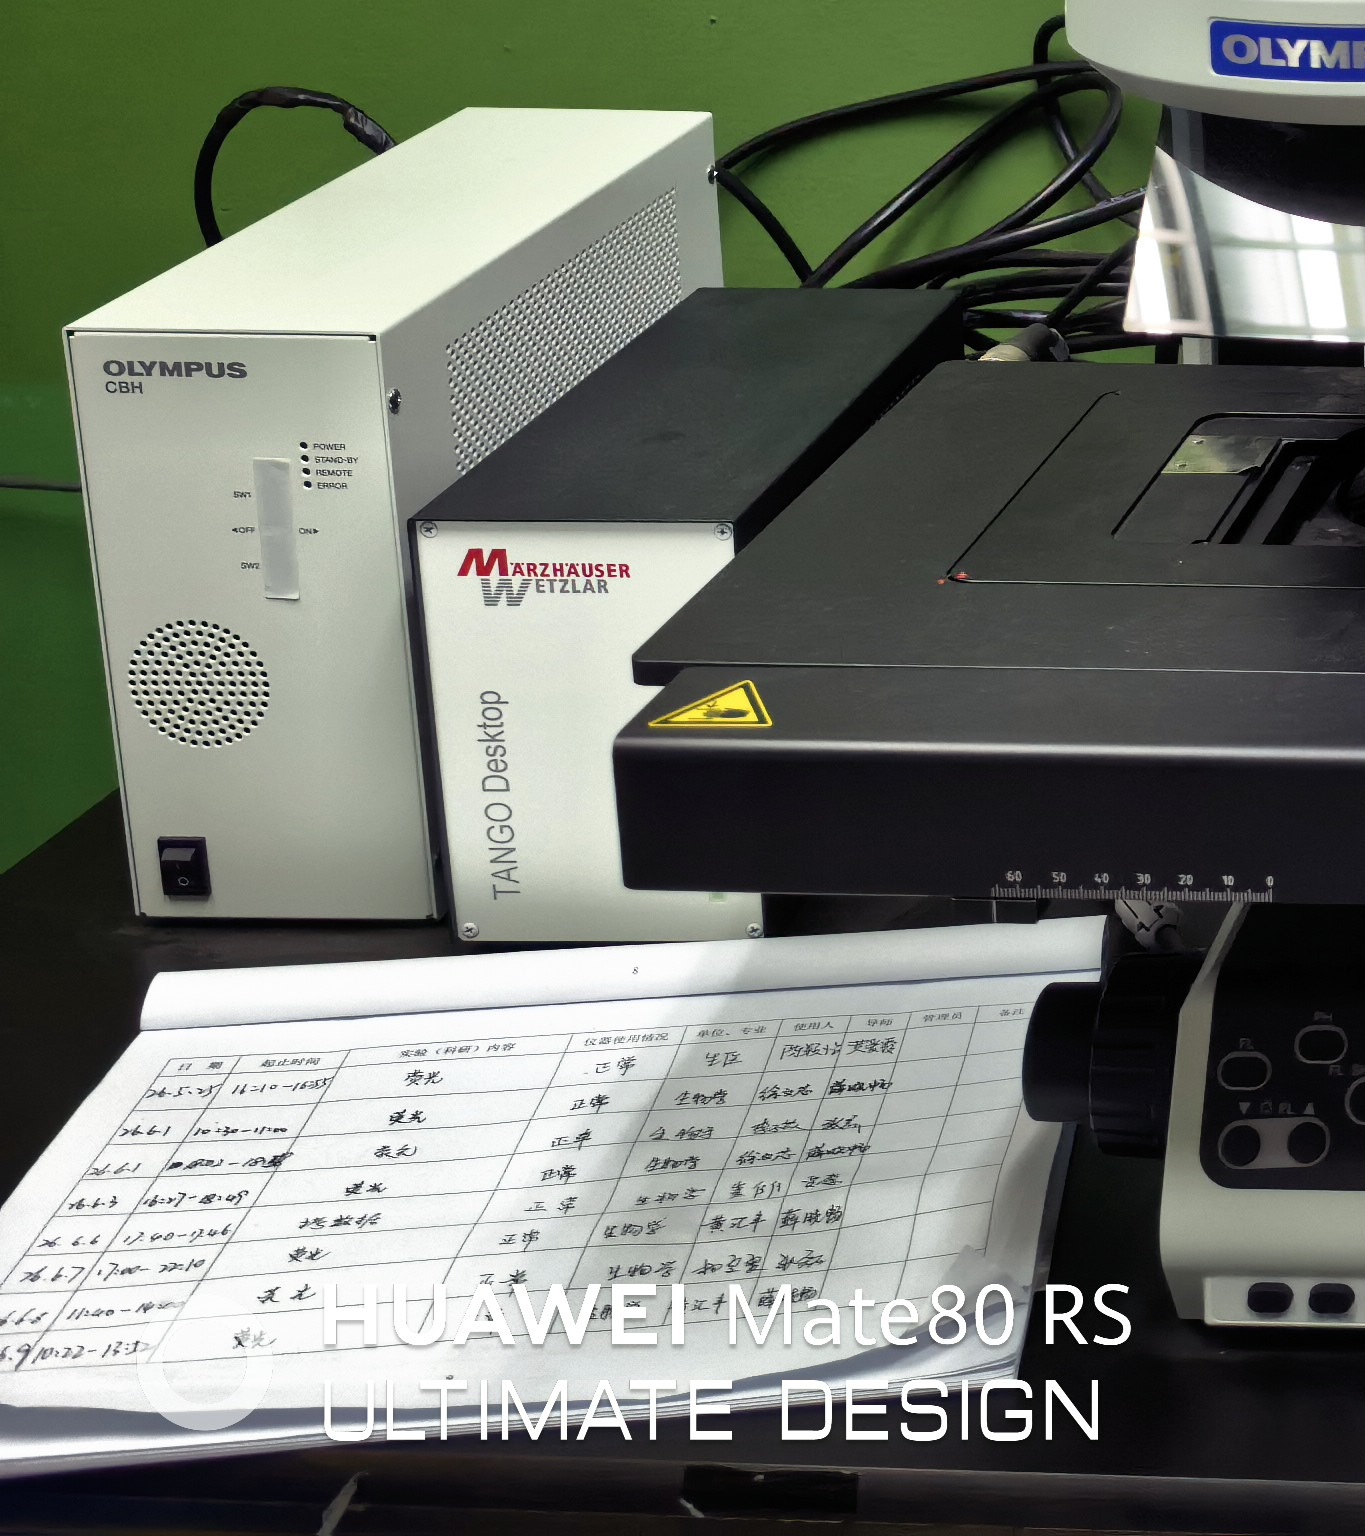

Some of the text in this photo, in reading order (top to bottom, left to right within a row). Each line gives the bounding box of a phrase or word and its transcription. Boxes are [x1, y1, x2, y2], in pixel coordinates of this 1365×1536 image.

[103, 360, 247, 379] OLYMPUS
[105, 381, 143, 394] CBH
[477, 690, 520, 900] TANGO Desktop
[1052, 872, 1066, 882] 50
[1137, 874, 1151, 884] 30
[1178, 874, 1193, 885] 20
[1222, 875, 1234, 885] 10
[794, 1021, 834, 1031] 使用人
